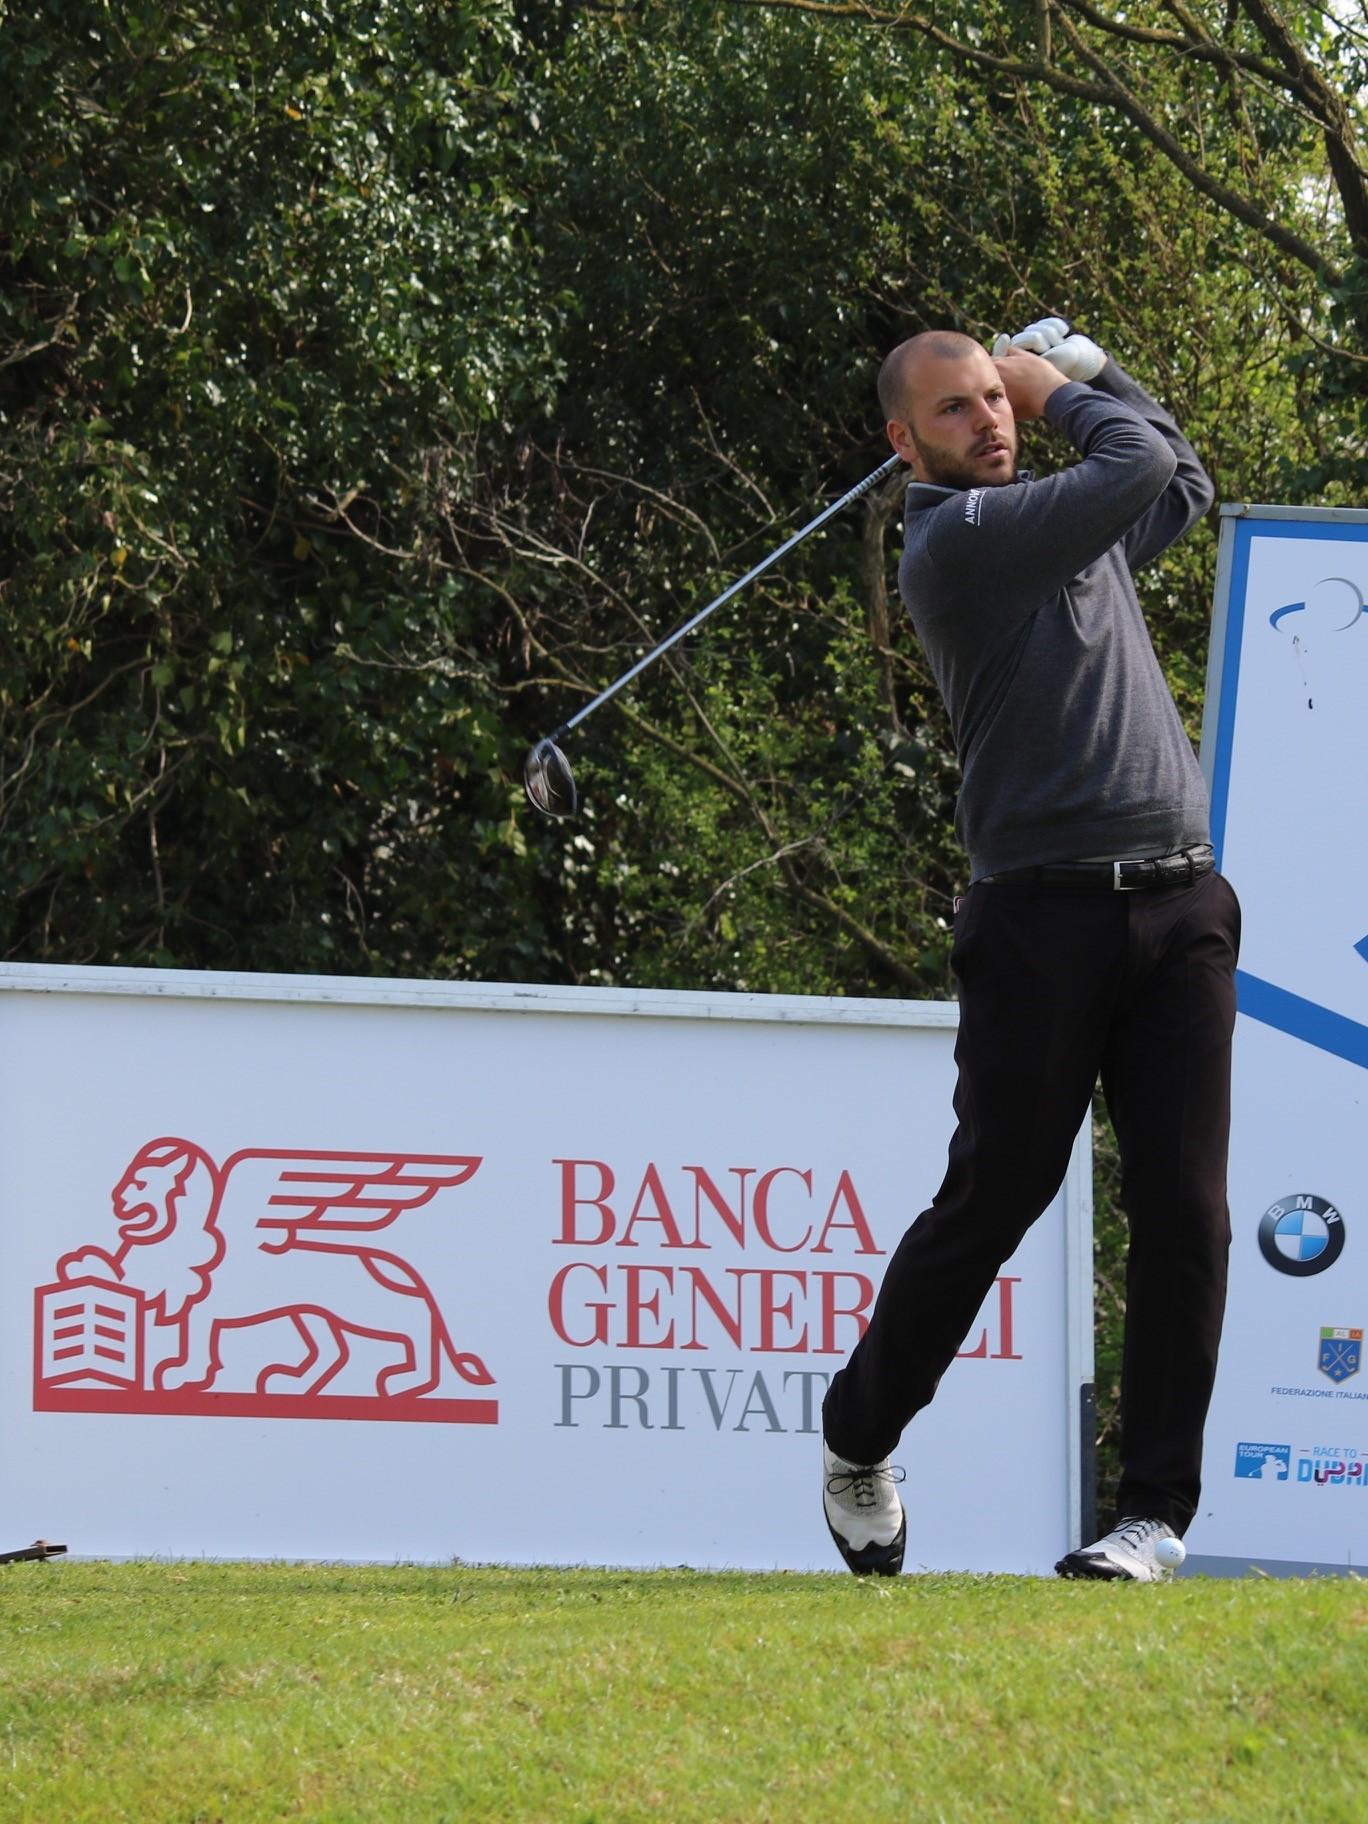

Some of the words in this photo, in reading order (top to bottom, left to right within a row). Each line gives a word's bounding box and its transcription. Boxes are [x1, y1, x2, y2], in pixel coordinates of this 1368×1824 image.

[551, 1158, 887, 1256] BANCA
[1267, 1195, 1341, 1225] BMW
[1271, 1386, 1333, 1398] FEDERAZIONE
[553, 1363, 830, 1435] PRIVAT
[1239, 1445, 1288, 1454] EUROPEAN
[1239, 1451, 1264, 1459] TOUR
[1313, 1446, 1340, 1457] RACE
[1344, 1448, 1357, 1458] TO
